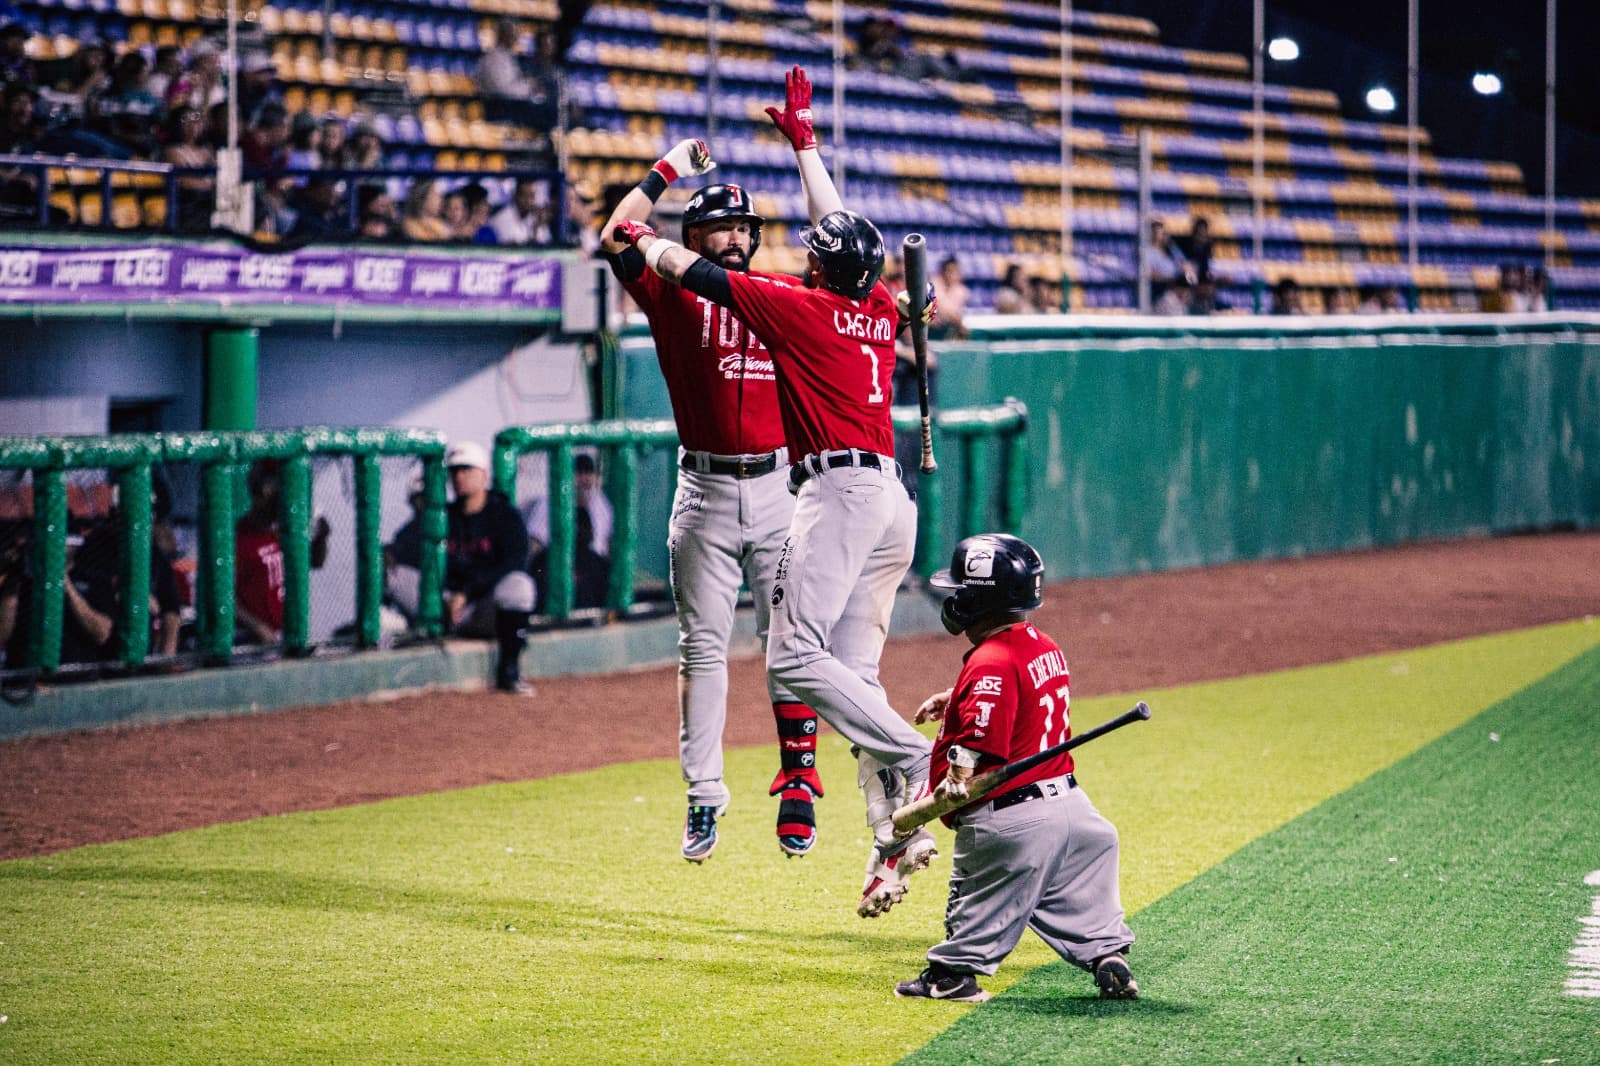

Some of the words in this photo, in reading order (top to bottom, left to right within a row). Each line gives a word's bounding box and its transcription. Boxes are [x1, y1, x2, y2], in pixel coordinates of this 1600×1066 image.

[834, 310, 891, 341] CASTRO
[718, 353, 774, 371] Calient
[861, 345, 883, 403] 1
[973, 675, 1003, 695] abc
